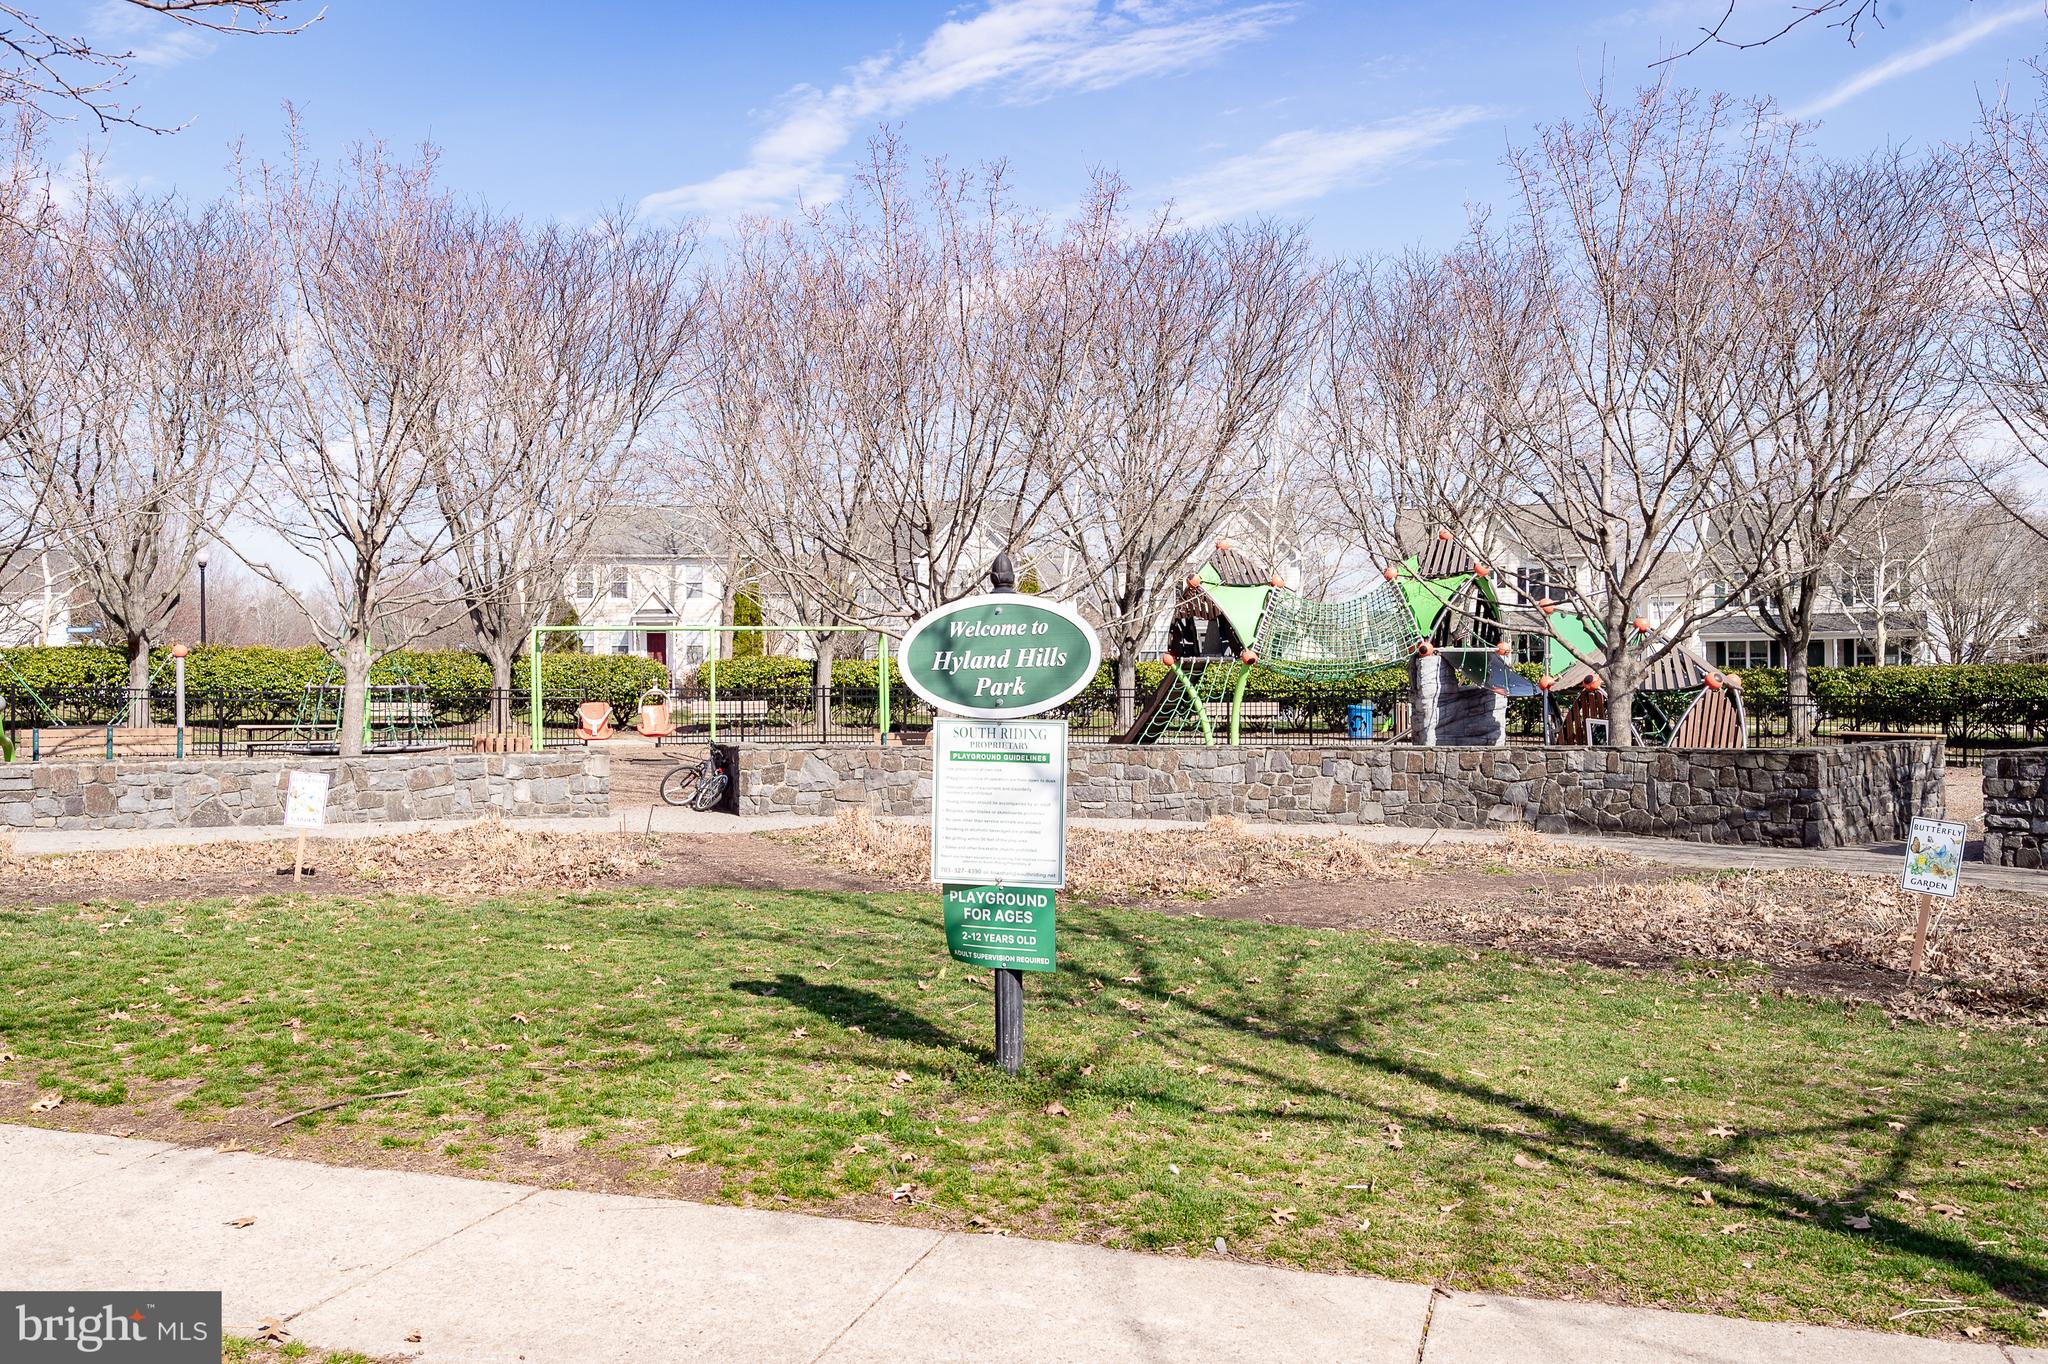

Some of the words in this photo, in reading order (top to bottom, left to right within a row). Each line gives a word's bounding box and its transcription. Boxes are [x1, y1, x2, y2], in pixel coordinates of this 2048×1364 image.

[949, 619, 1027, 638] Welcome
[1031, 619, 1048, 636] to
[931, 649, 1010, 675] Hyland
[1014, 646, 1068, 669] Hills
[975, 677, 1026, 696] Park
[953, 726, 996, 739] SOUTH
[1000, 727, 1047, 740] RIDING
[969, 741, 1029, 750] PROPRIETARY
[952, 752, 1002, 761] PLAYGROUND
[1003, 754, 1047, 762] GUIDELINES
[1914, 824, 1962, 836] BUTTERFLY
[1911, 878, 1947, 890] GARDEN
[949, 890, 1048, 908] PLAYGROUND
[963, 907, 991, 921] FOR
[994, 909, 1033, 924] AGES
[962, 931, 982, 941] 2-12
[983, 933, 1015, 944] YEARS
[1016, 936, 1037, 945] OLD
[954, 949, 973, 958] ADULT
[973, 952, 1016, 962] SUPERVISION
[1015, 956, 1050, 965] REQUIRED
